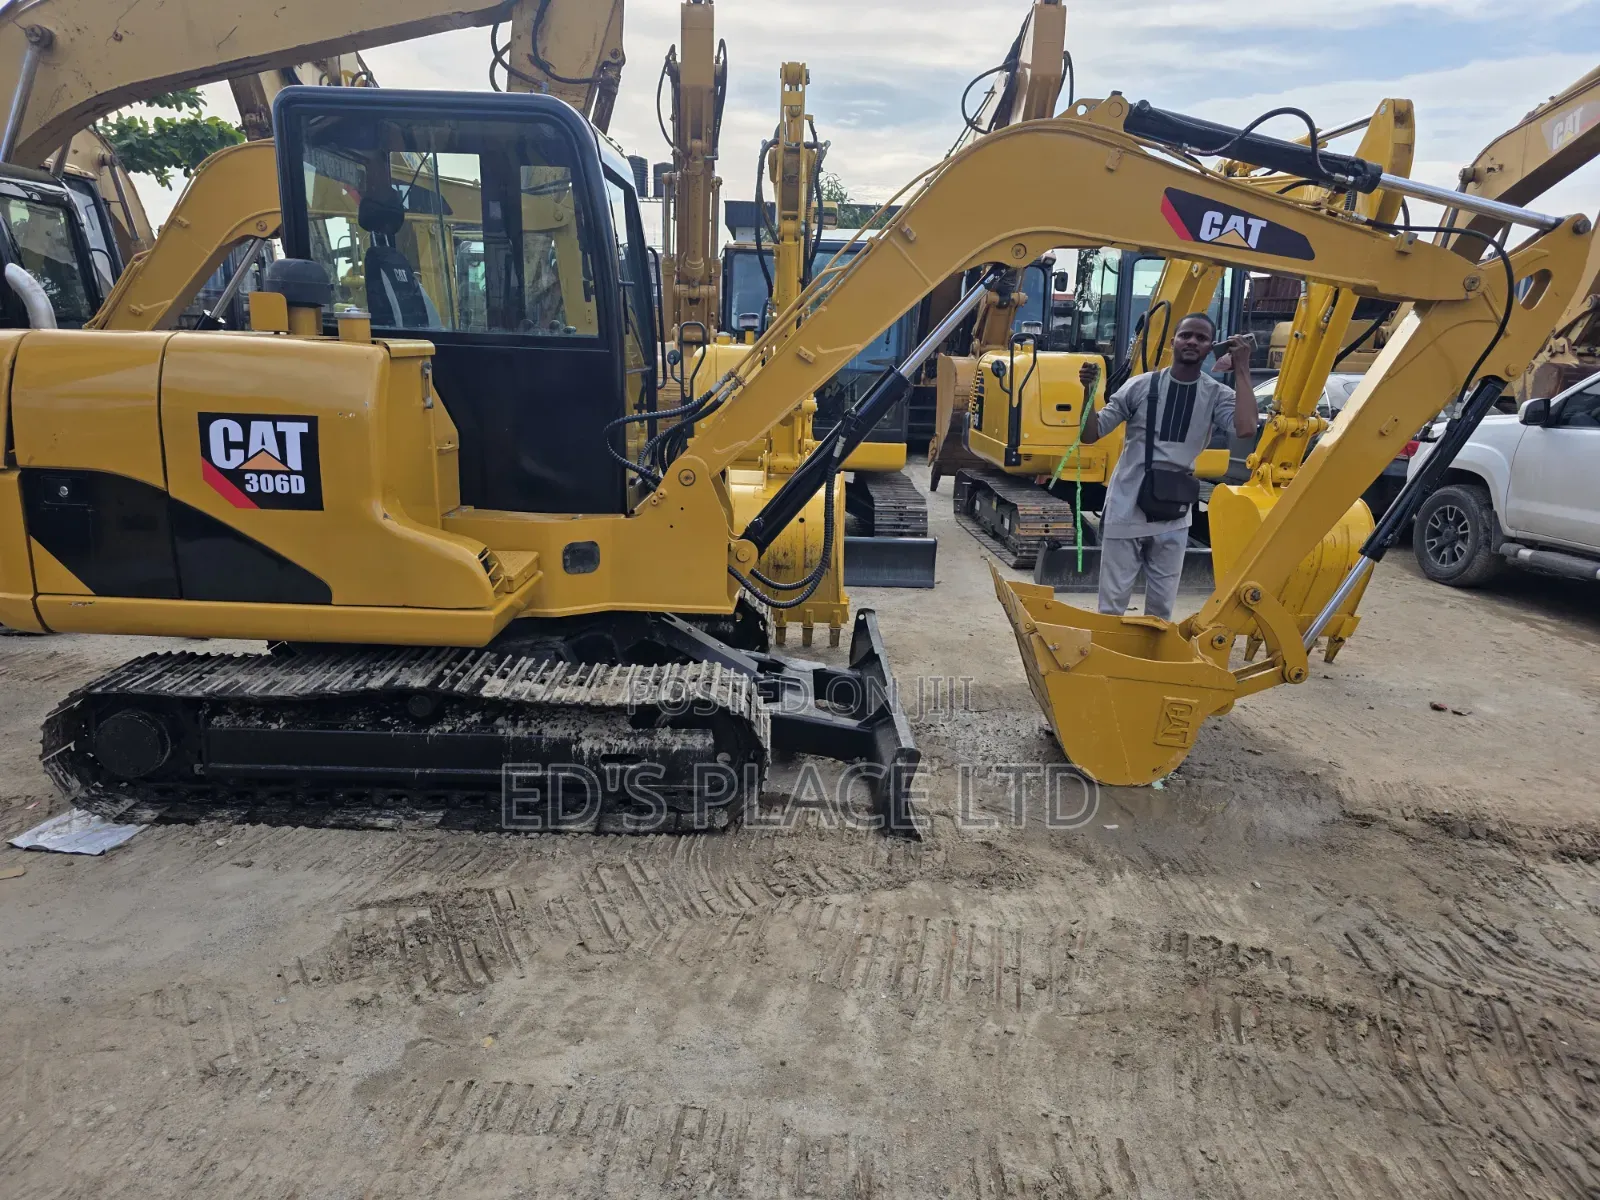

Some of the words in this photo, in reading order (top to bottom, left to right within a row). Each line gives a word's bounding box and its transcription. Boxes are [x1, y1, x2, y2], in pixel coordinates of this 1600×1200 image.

[1552, 106, 1584, 151] CAT
[1199, 210, 1268, 249] CAT
[209, 418, 308, 471] CAT
[244, 473, 306, 494] 306D
[1161, 702, 1193, 745] CAT
